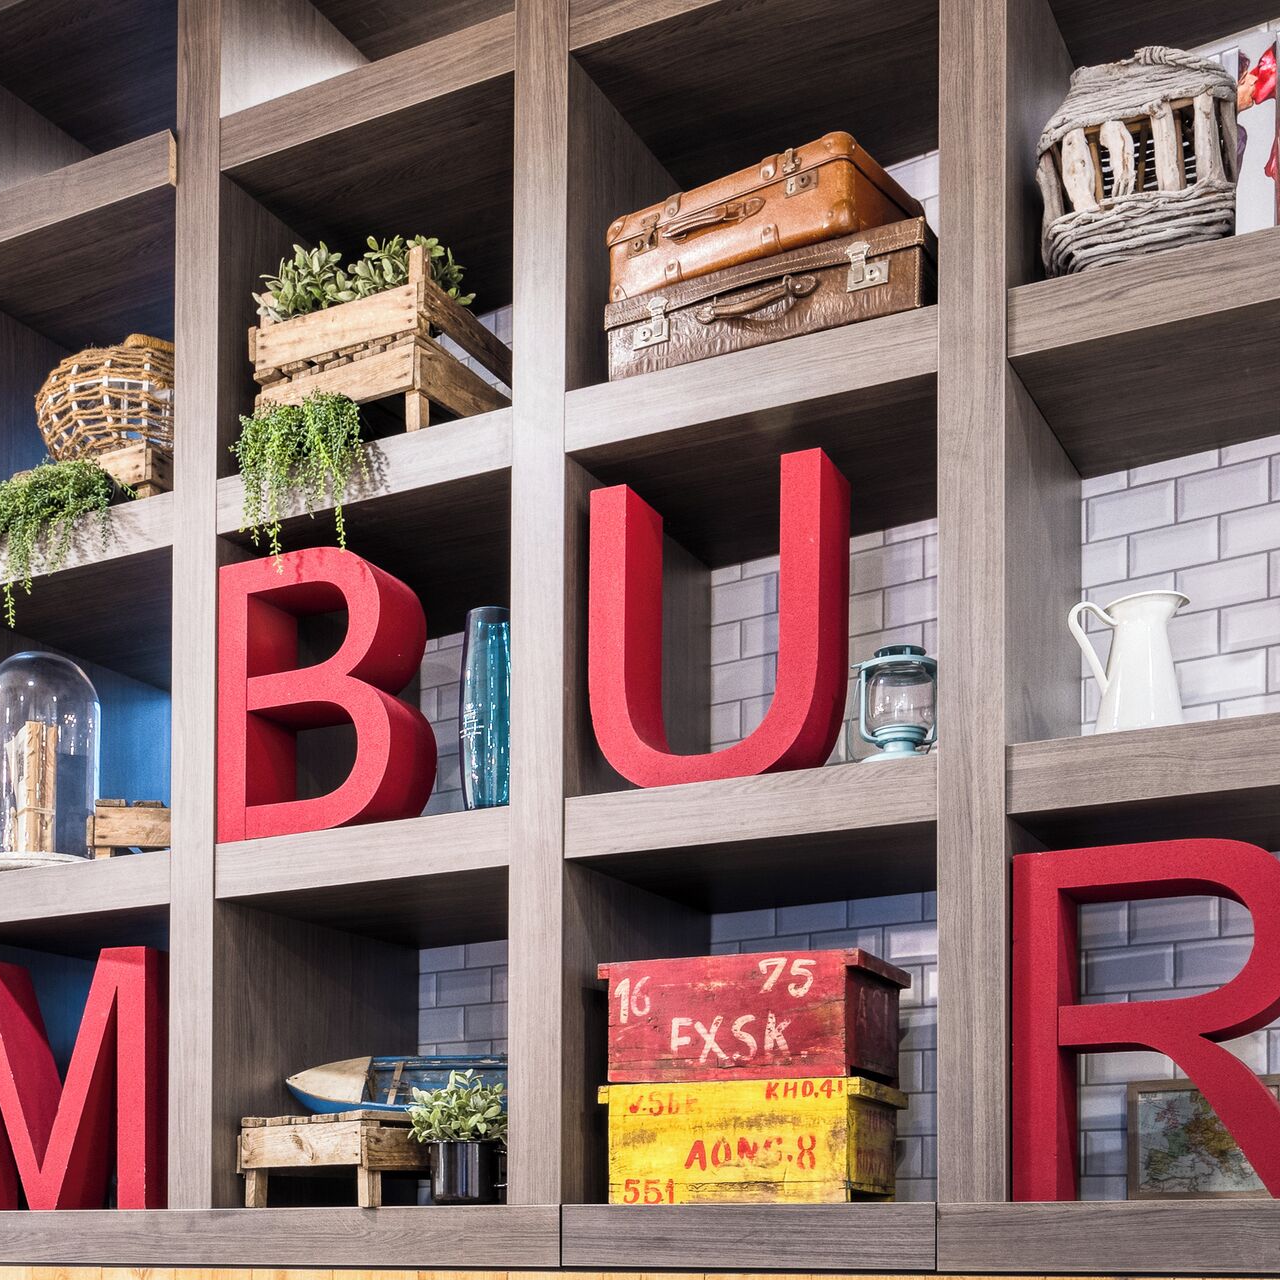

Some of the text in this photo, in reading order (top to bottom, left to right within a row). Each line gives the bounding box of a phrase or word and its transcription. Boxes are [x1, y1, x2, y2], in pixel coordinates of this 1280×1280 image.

[758, 957, 816, 998] 75
[614, 975, 651, 1024] 16
[624, 1178, 674, 1204] 551
